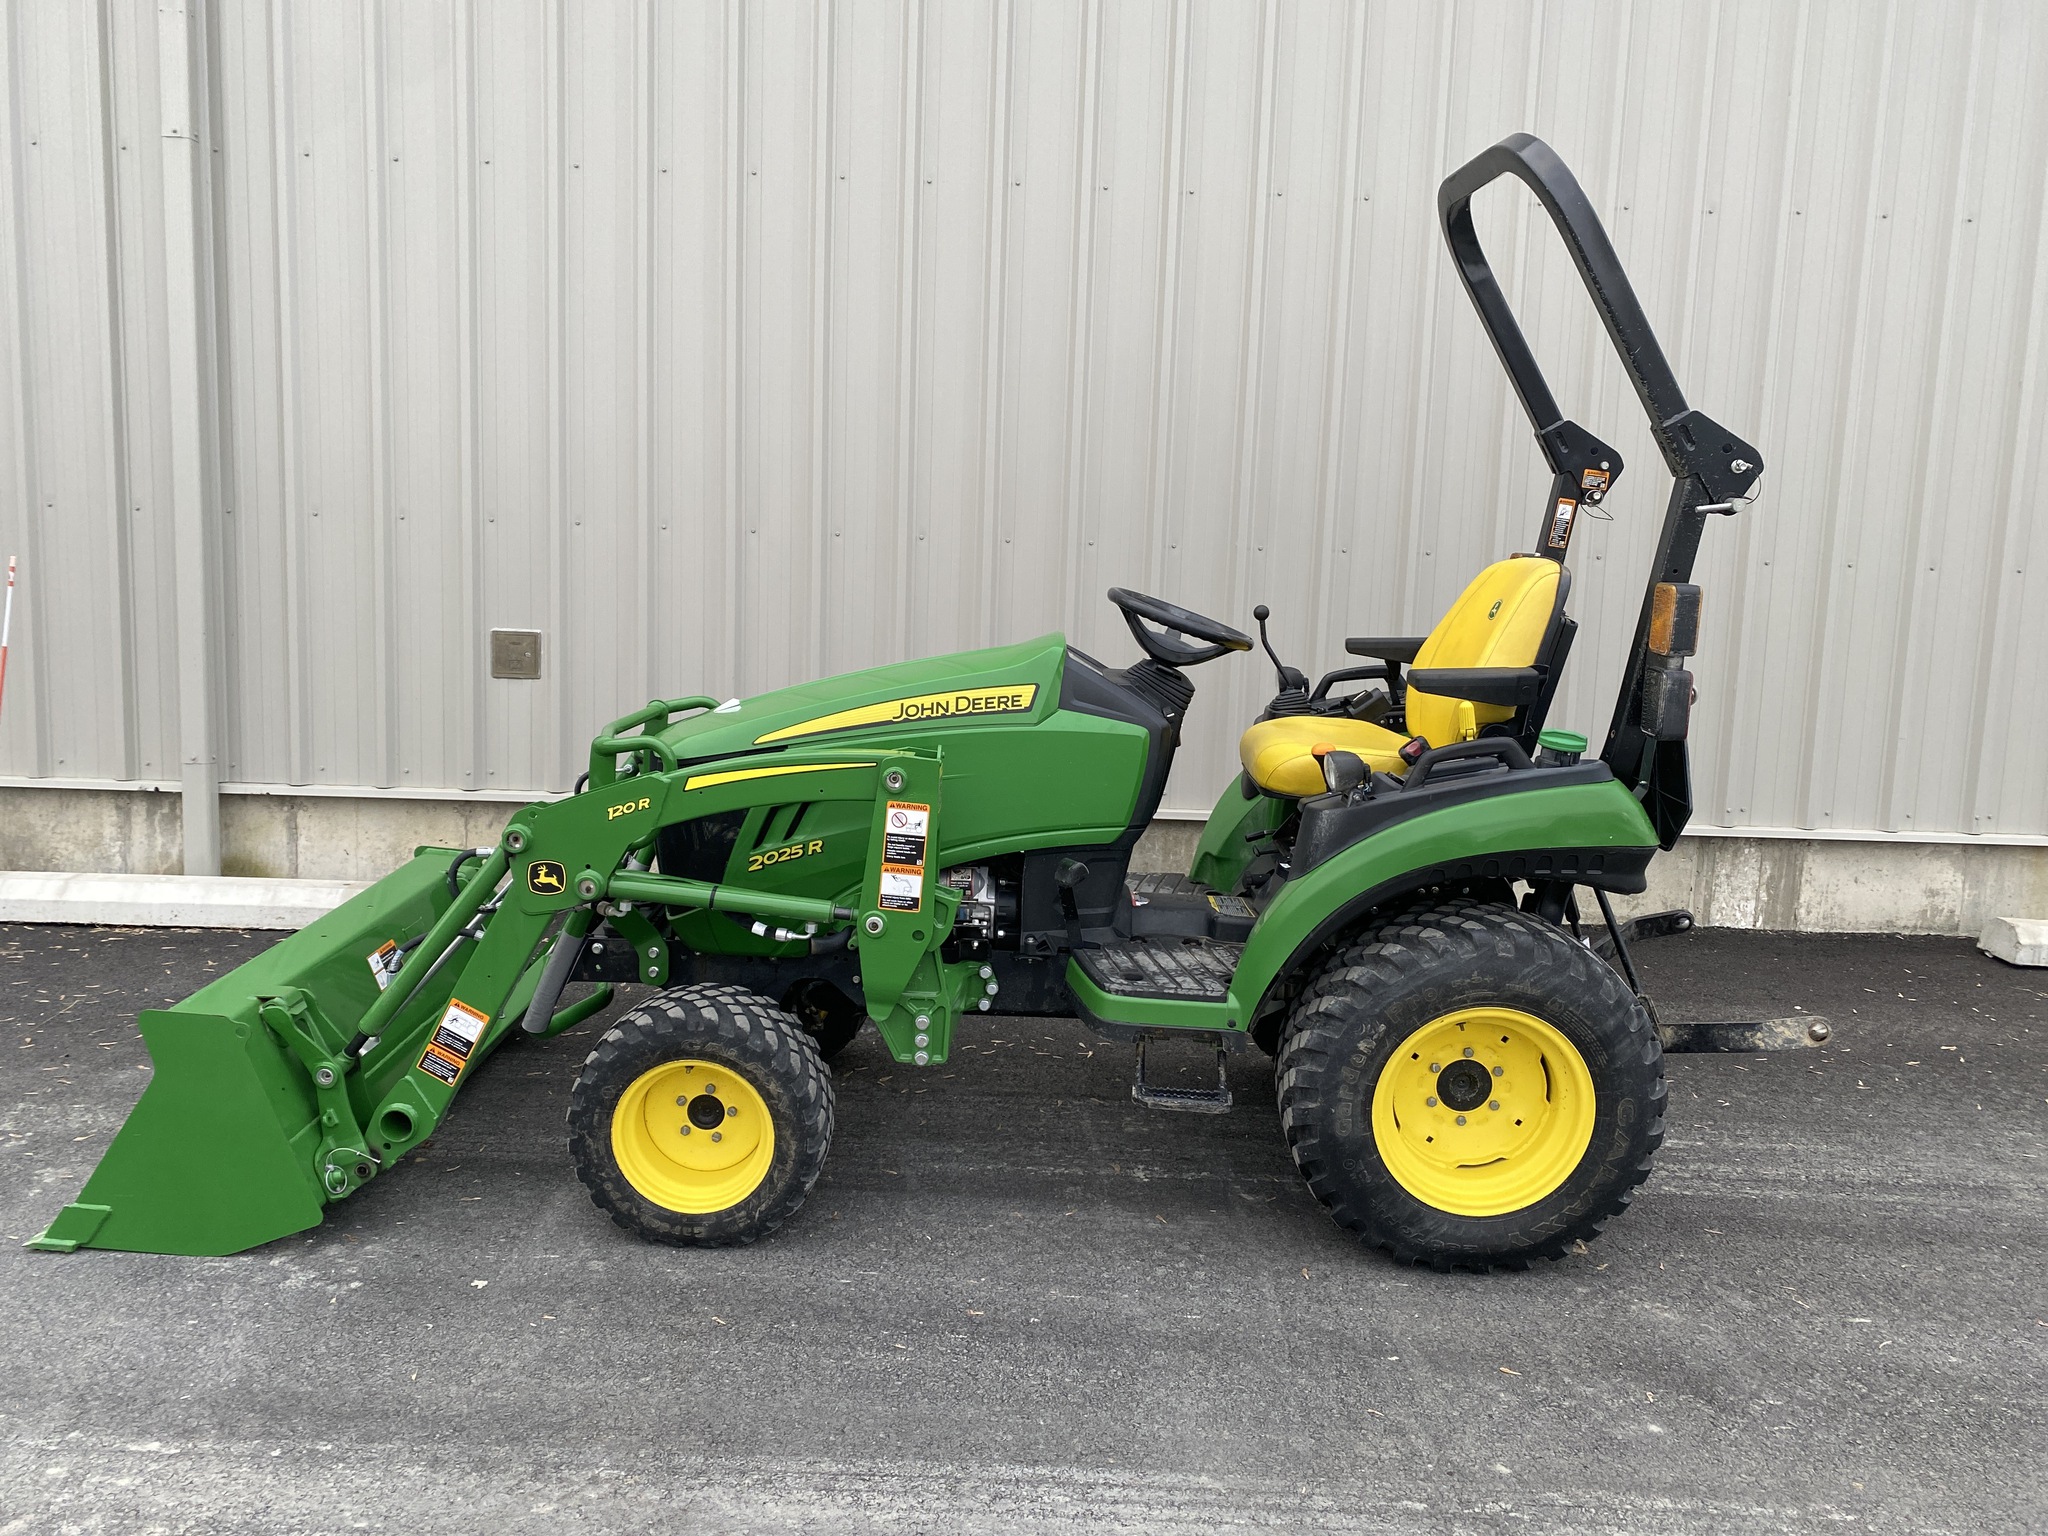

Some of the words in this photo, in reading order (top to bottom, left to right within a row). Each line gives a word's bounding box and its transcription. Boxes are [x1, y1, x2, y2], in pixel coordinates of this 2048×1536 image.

[892, 700, 950, 720] JOHN
[955, 694, 1023, 713] DEERE
[607, 801, 637, 821] 120
[637, 797, 651, 811] R
[896, 802, 928, 811] WARNING
[747, 843, 805, 873] 2025
[807, 839, 824, 856] R
[890, 866, 922, 875] WARNING
[460, 1004, 485, 1020] WARNING
[437, 1049, 461, 1066] WARNING
